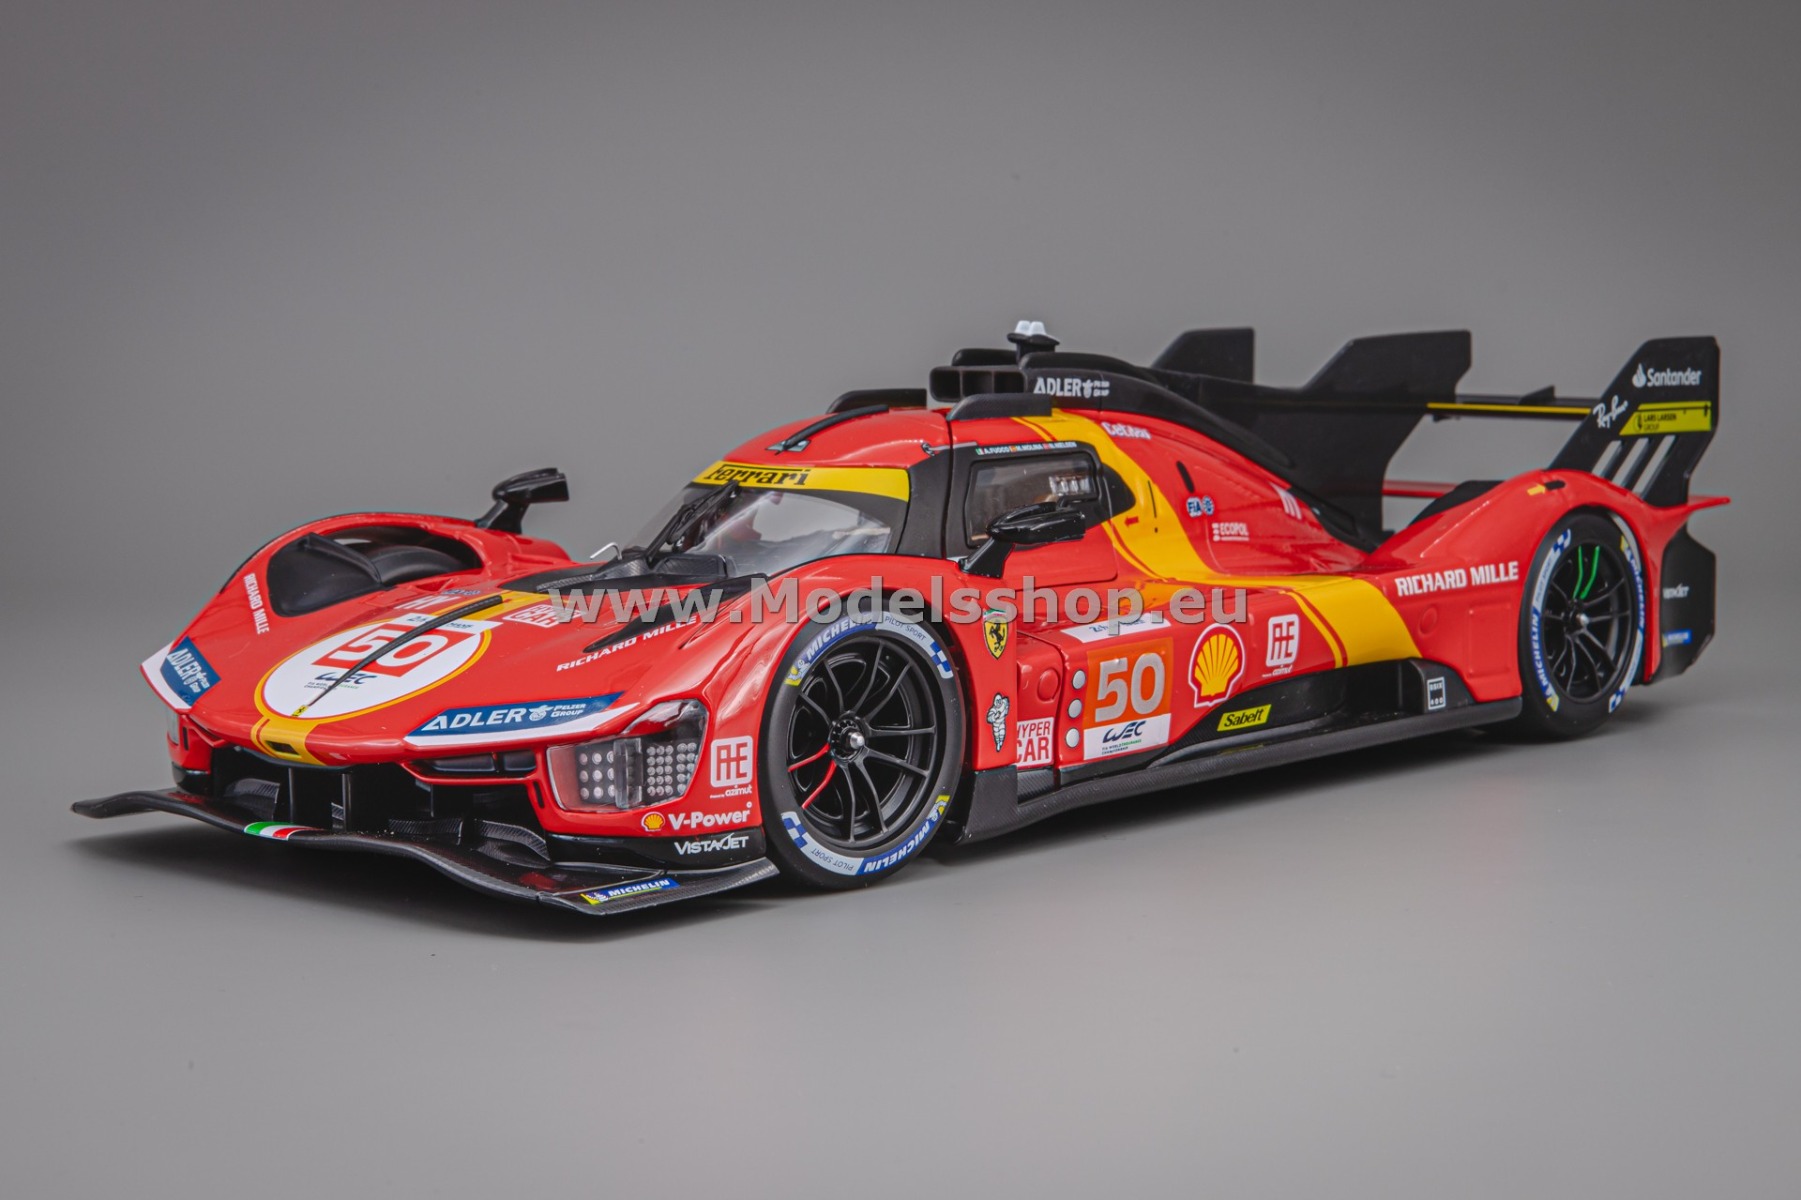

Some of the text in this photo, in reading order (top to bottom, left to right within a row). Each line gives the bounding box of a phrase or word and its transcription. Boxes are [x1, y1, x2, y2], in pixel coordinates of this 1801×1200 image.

[1033, 376, 1083, 398] ADLER
[1647, 367, 1702, 388] Santander
[703, 464, 811, 486] Ferrari
[1220, 522, 1249, 536] ECOPOL
[1394, 560, 1520, 598] RICHARD MILLE
[243, 572, 271, 635] RICHARD MILLE
[805, 612, 874, 662] MICHELIN
[884, 615, 927, 641] PILOT SPORT
[327, 628, 449, 667] 50
[556, 615, 697, 673] RICHARD MILLE
[1531, 612, 1550, 687] MICHELIN
[166, 647, 202, 681] ADLER
[1095, 652, 1166, 723] 50
[421, 703, 586, 732] ADLER PELZER
[550, 709, 584, 718] GROUP
[1224, 707, 1264, 728] Sabelt
[1102, 720, 1147, 744] WEC
[725, 784, 752, 797] azimut
[668, 809, 750, 831] V-Power
[811, 847, 854, 872] PILOT SPORT
[863, 821, 931, 873] MICHELIN
[607, 877, 671, 897] MICHELIN
